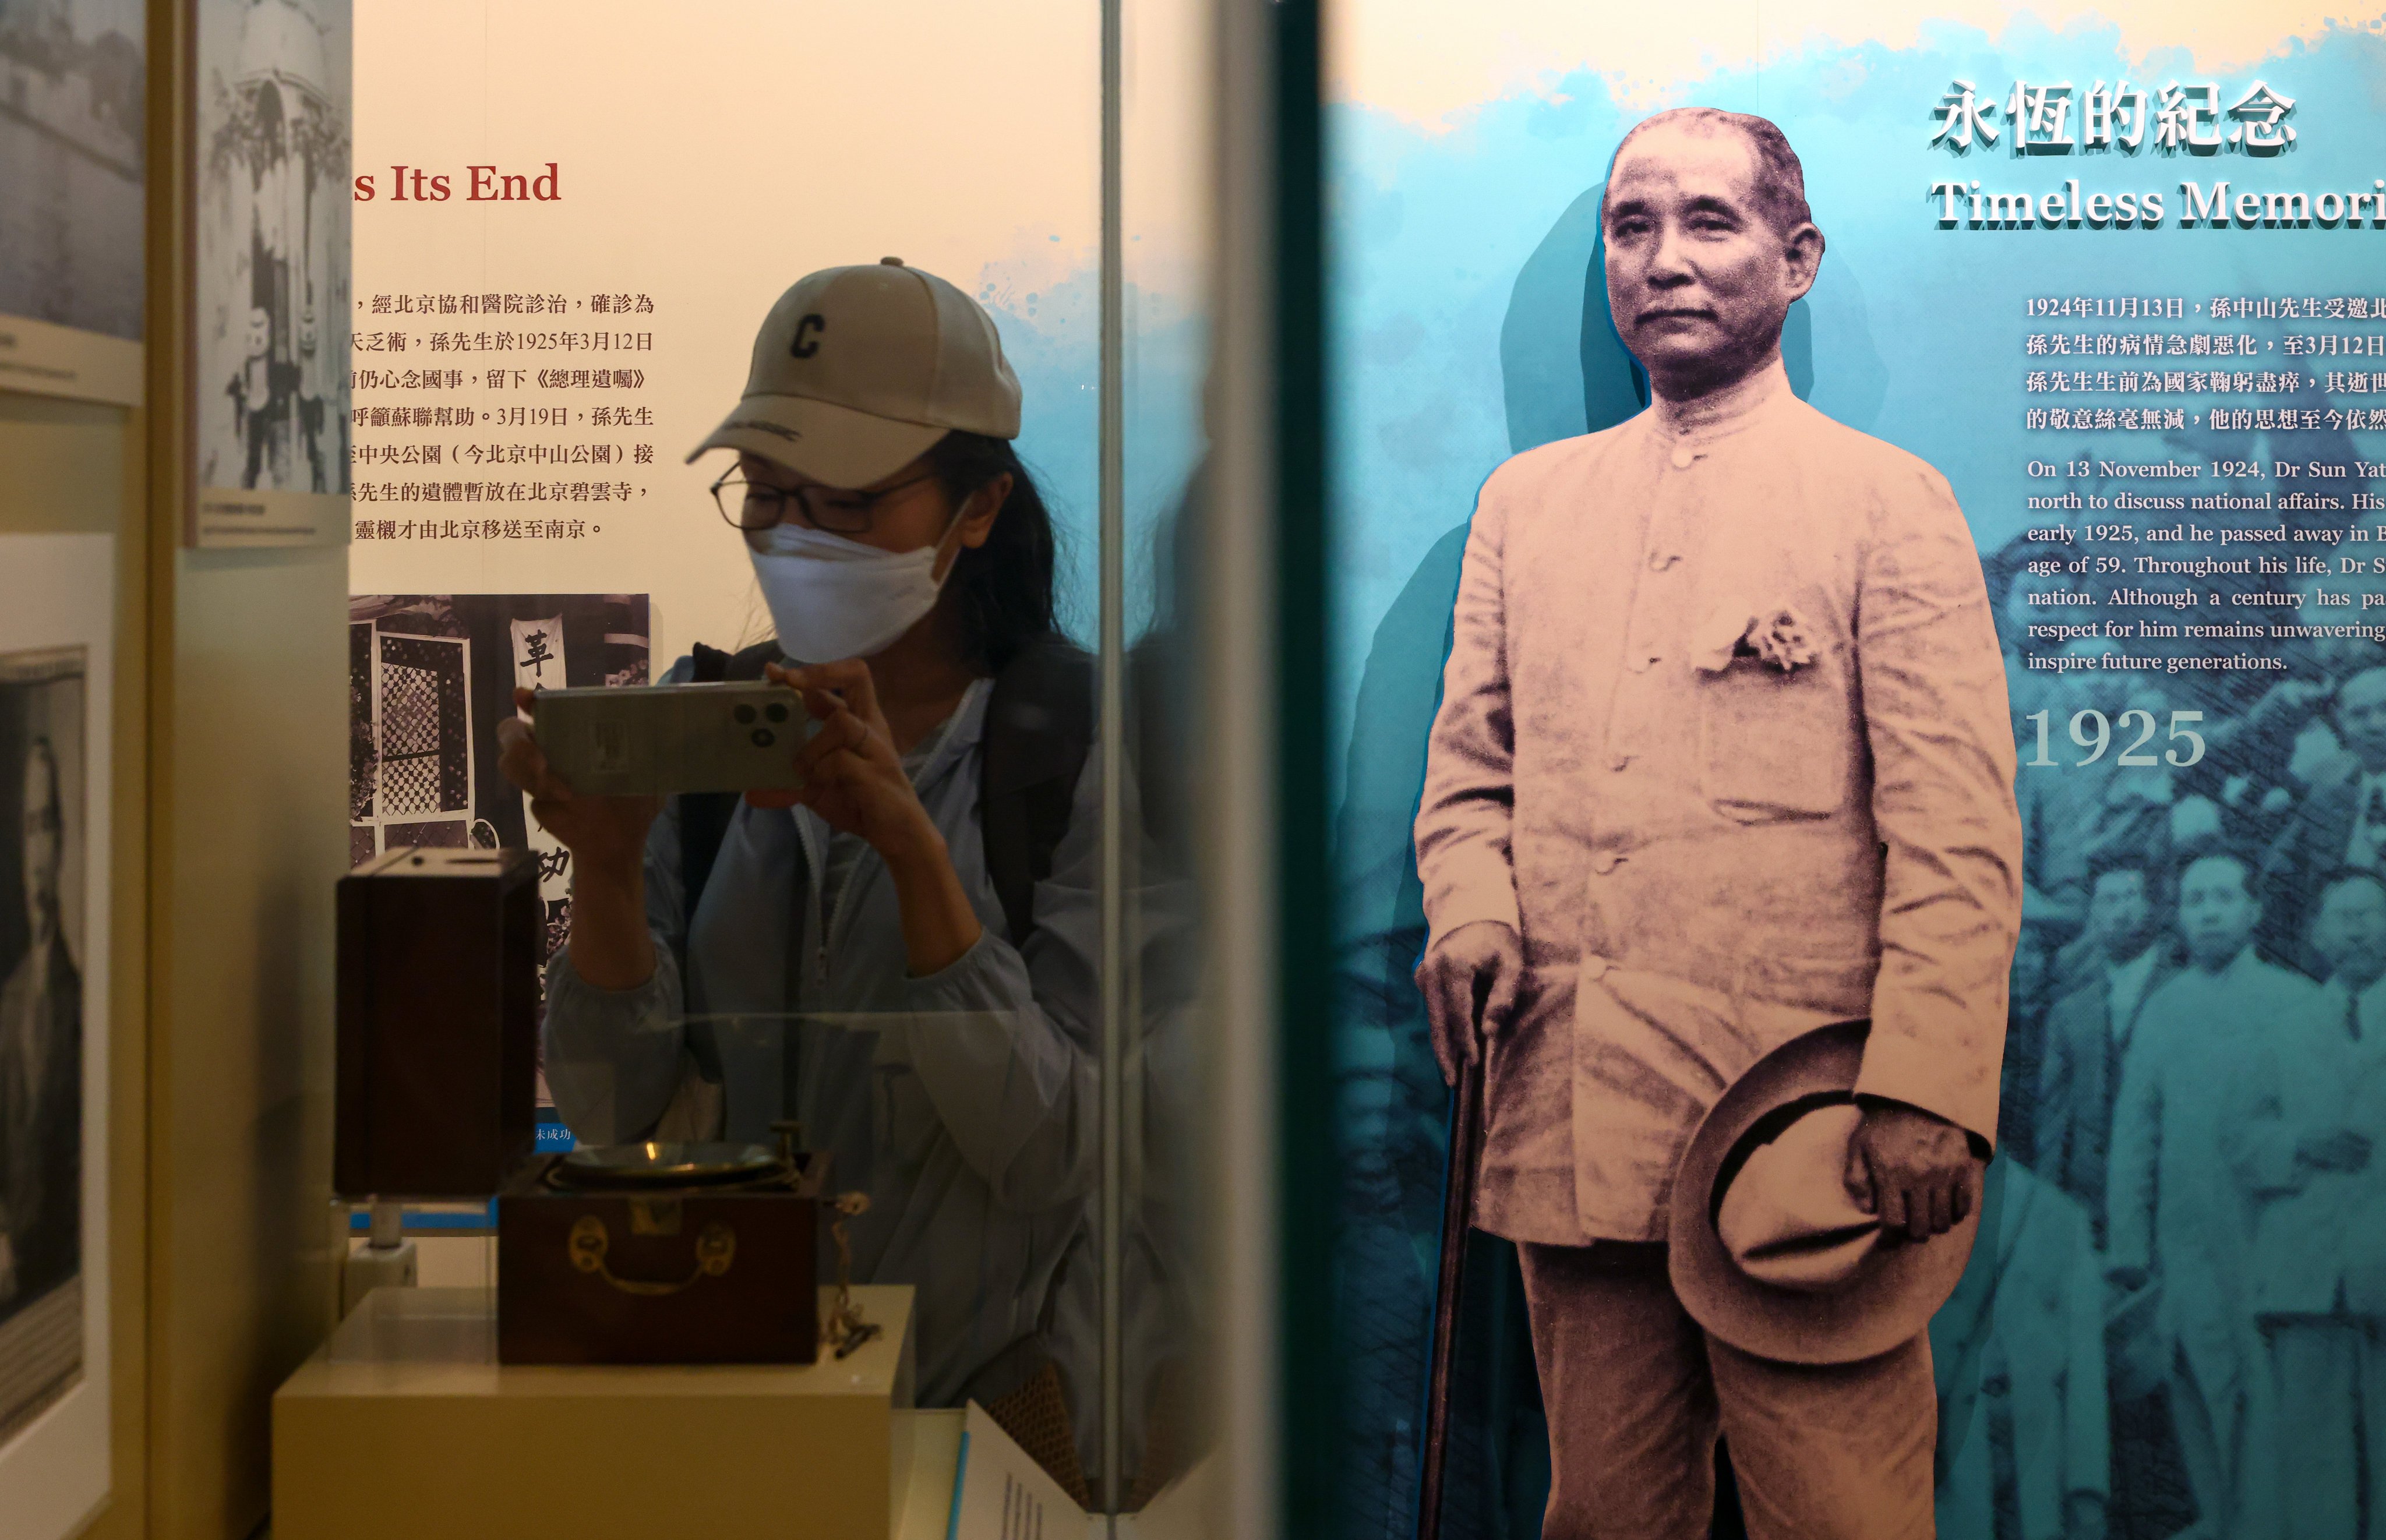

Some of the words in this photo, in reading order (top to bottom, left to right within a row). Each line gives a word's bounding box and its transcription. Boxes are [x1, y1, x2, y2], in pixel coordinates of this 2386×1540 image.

[1932, 79, 2297, 149] 永恆的紀念
[354, 176, 375, 202] s
[391, 166, 451, 202] Its
[466, 163, 562, 201] End
[1932, 179, 2164, 221] Timeless
[2182, 179, 2386, 221] Memori
[790, 313, 825, 359] C
[2028, 461, 2056, 476] On
[2067, 461, 2089, 476] 13
[2099, 461, 2201, 477] November
[2212, 461, 2265, 480] 1924,
[2275, 462, 2300, 476] Dr
[2309, 462, 2346, 477] Sun
[2355, 462, 2386, 477] Yat
[2028, 492, 2082, 508] north
[2089, 495, 2108, 508] to
[2115, 492, 2184, 508] discuss
[2191, 493, 2271, 509] national
[2278, 493, 2344, 509] affairs.
[2352, 493, 2385, 509] His
[2028, 524, 2077, 545] early
[2085, 525, 2138, 544] 1925,
[2147, 525, 2183, 541] and
[2190, 525, 2213, 541] he
[2221, 525, 2286, 545] passed
[2294, 530, 2343, 545] away
[2350, 525, 2369, 541] in
[2028, 561, 2060, 577] age
[2069, 556, 2089, 573] of
[2096, 557, 2126, 573] 59.
[2134, 556, 2251, 577] Throughout
[2258, 557, 2287, 573] his
[2295, 557, 2331, 576] life,
[2341, 558, 2366, 573] Dr
[2374, 558, 2386, 573] S
[2028, 588, 2096, 605] nation.
[2108, 588, 2198, 609] Although
[2210, 594, 2220, 605] a
[2232, 591, 2306, 609] century
[2317, 589, 2350, 605] has
[2362, 594, 2386, 609] pa
[2028, 623, 2098, 641] respect
[2105, 620, 2133, 637] for
[2139, 620, 2177, 637] him
[2184, 621, 2264, 637] remains
[2270, 621, 2385, 641] unwavering
[2028, 652, 2096, 673] inspire
[2102, 652, 2161, 669] future
[2167, 653, 2286, 673] generations.
[2026, 709, 2205, 767] 1925
